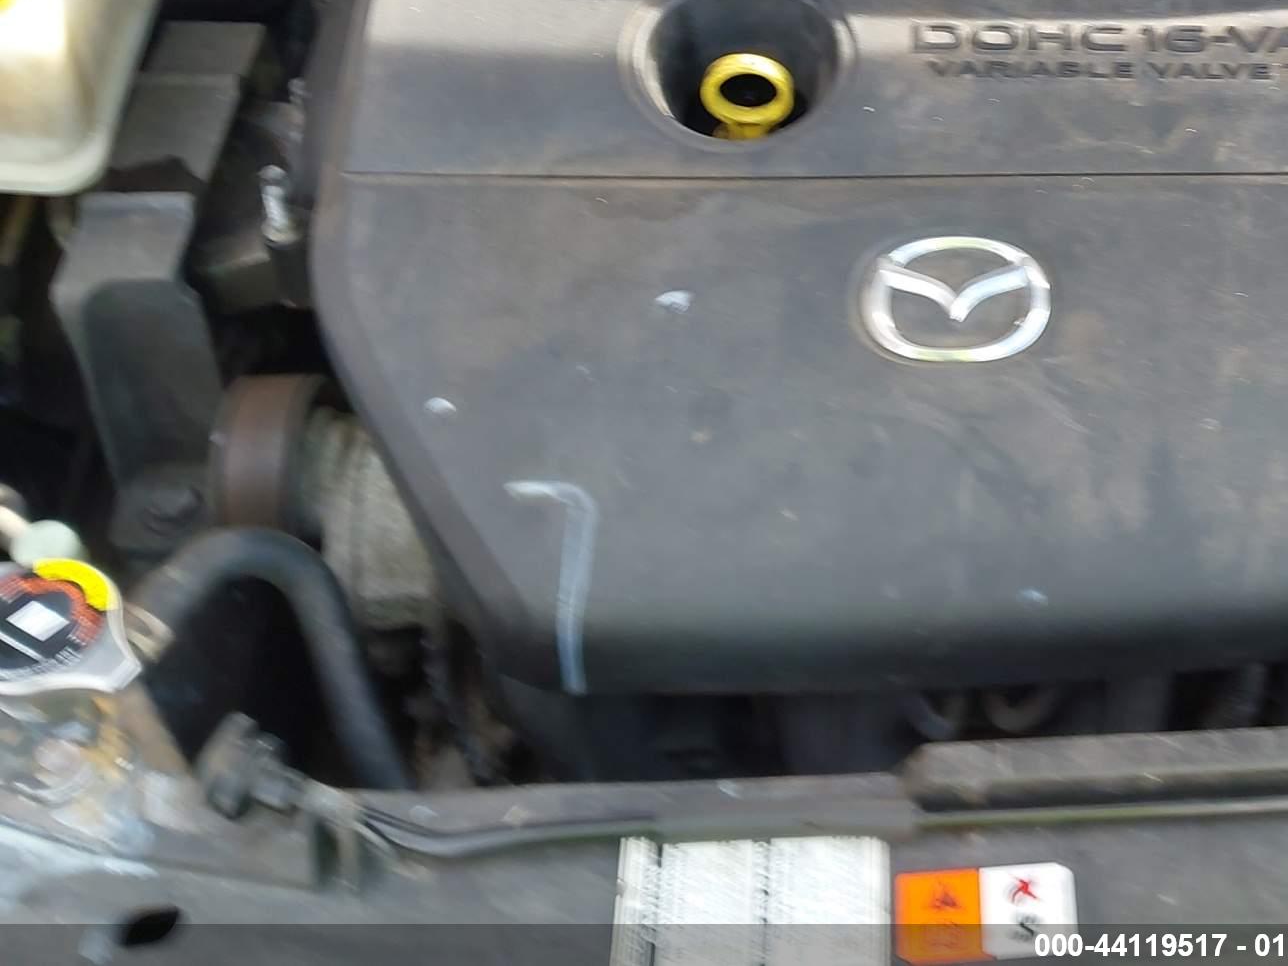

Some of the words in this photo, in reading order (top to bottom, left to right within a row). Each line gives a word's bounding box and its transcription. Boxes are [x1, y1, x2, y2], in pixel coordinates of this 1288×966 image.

[913, 22, 1128, 52] DOHC
[928, 61, 1136, 80] VARIABLE
[1149, 61, 1272, 80] VALVE
